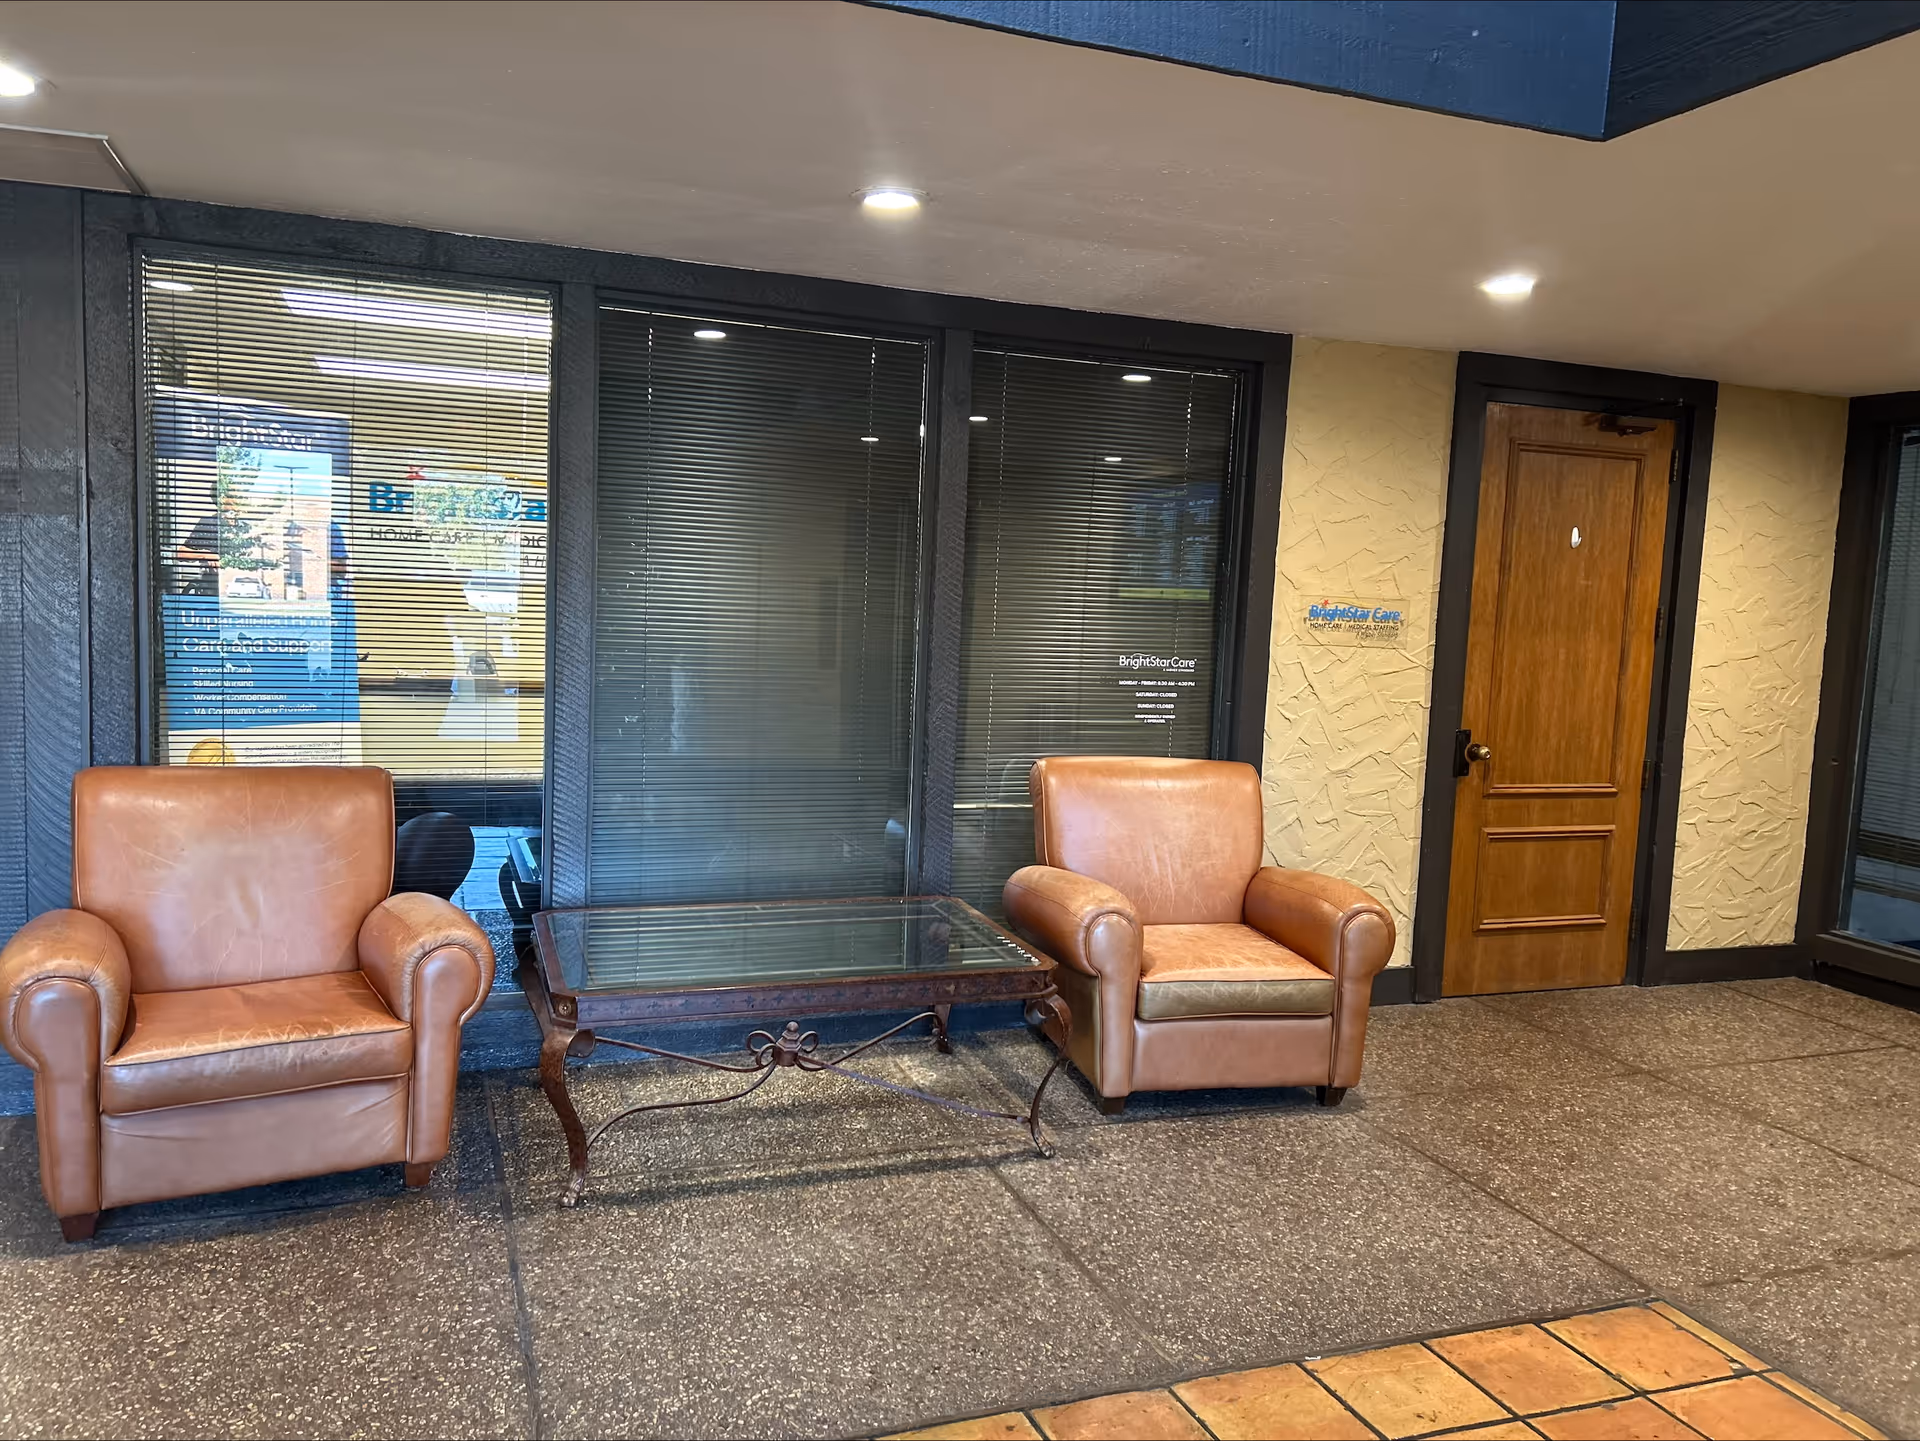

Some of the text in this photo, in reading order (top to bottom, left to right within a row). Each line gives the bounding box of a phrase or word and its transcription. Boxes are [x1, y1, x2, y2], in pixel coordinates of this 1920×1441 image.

[1309, 604, 1401, 621] BrightStar Care
[232, 637, 264, 652] and
[267, 638, 334, 656] Support
